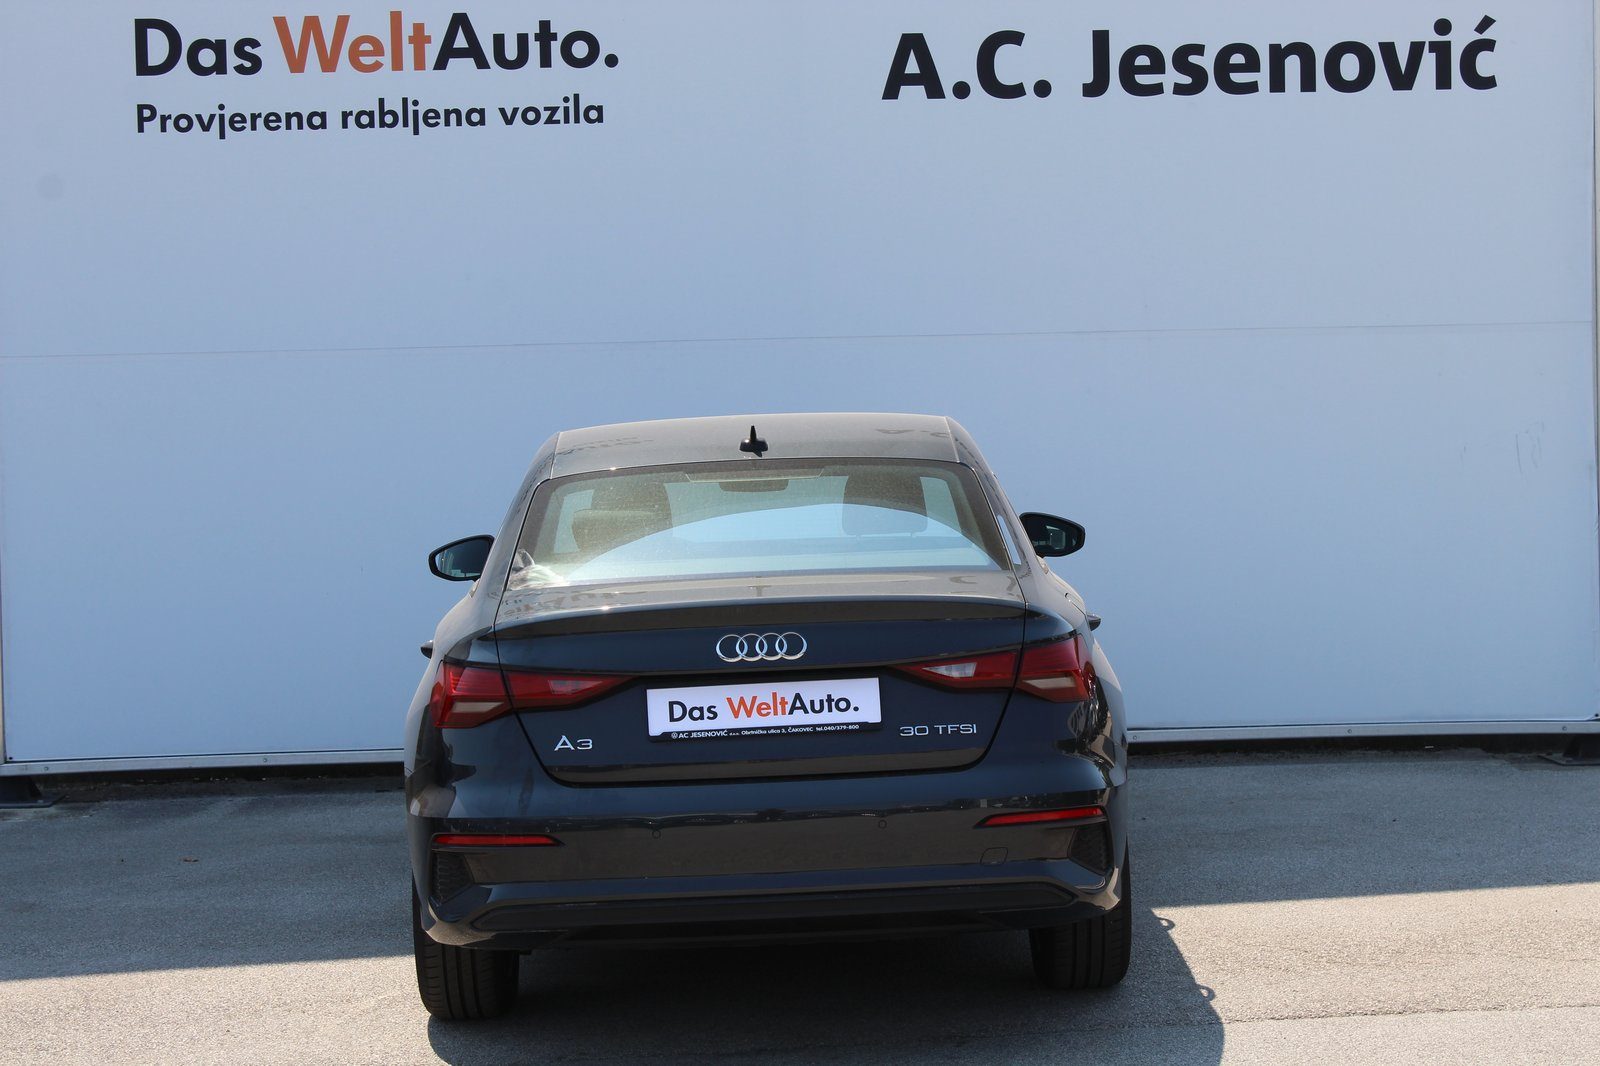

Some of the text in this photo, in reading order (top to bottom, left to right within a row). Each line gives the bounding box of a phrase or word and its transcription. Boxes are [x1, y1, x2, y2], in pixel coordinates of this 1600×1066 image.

[134, 11, 619, 76] Das WeltAuto.
[881, 14, 1498, 100] A.C. Jesenović
[136, 93, 605, 140] Provjerena rabljena vozila
[668, 691, 859, 722] Das WeltAuto.
[554, 735, 593, 751] A3
[690, 729, 728, 738] JESENOVIĆ
[900, 723, 977, 736] 30 TFSI
